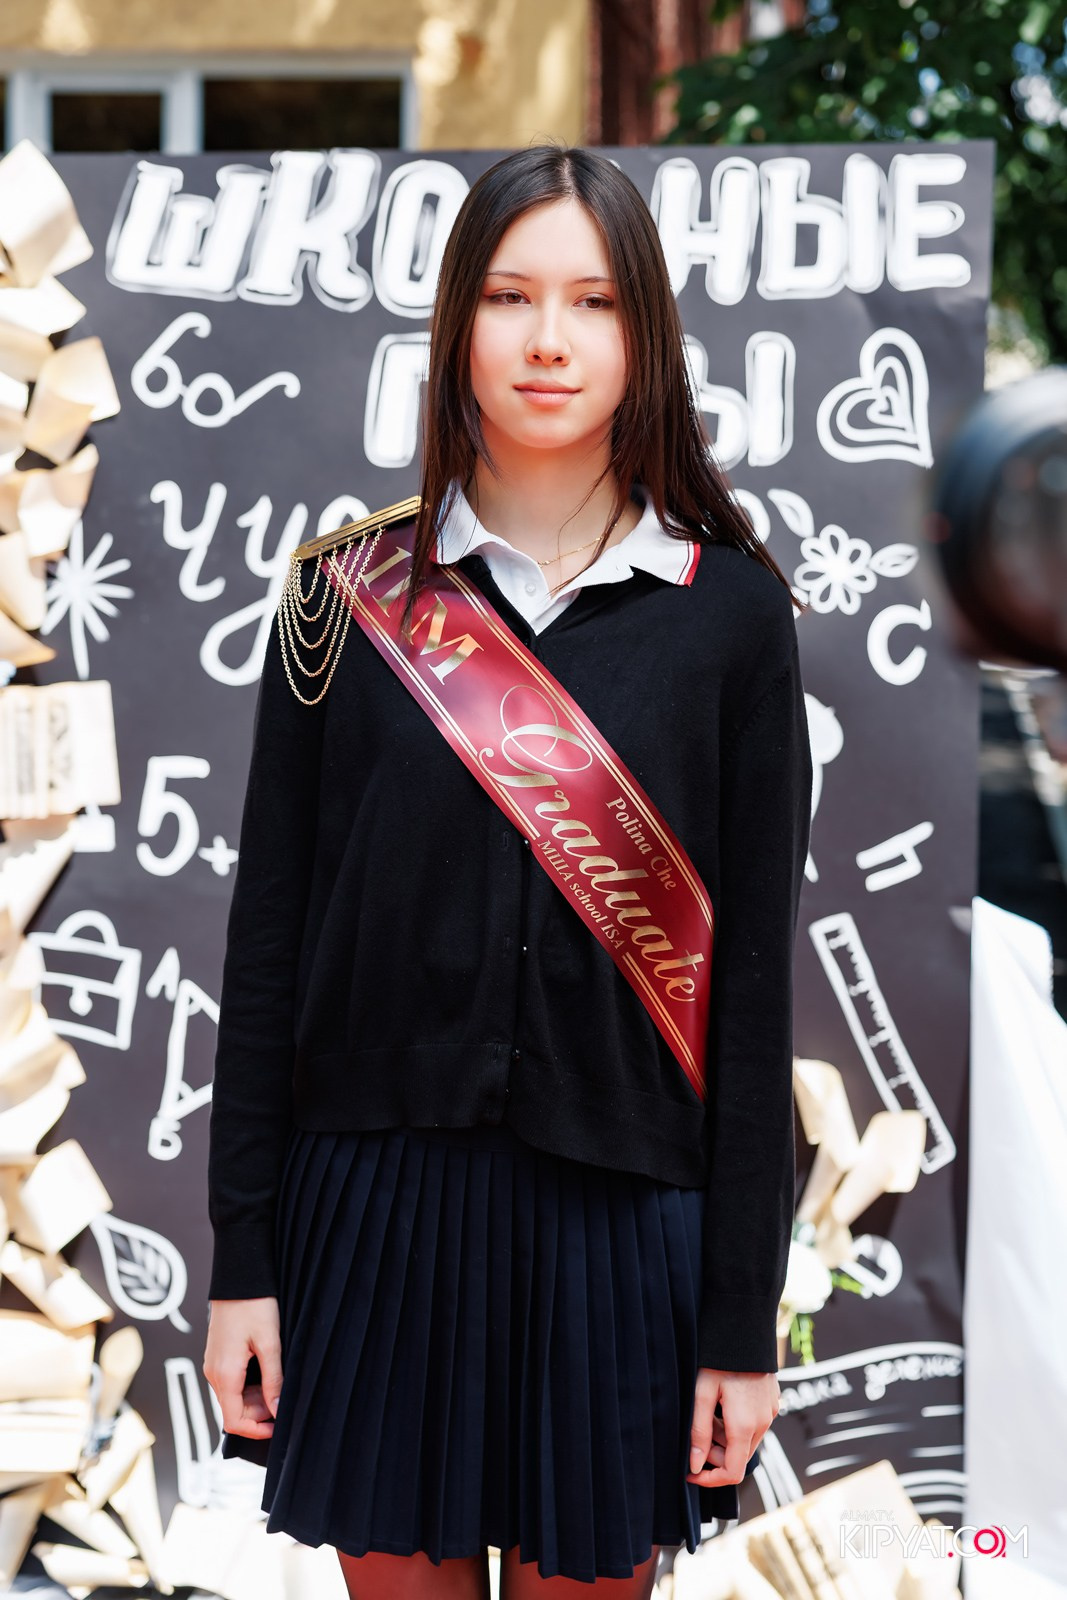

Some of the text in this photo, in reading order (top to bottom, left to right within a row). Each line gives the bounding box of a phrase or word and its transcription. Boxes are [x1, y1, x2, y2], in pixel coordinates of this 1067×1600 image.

[478, 685, 706, 1002] Graduate
[606, 797, 677, 890] Polina Che
[569, 882, 607, 925] school
[601, 921, 626, 950] ISA
